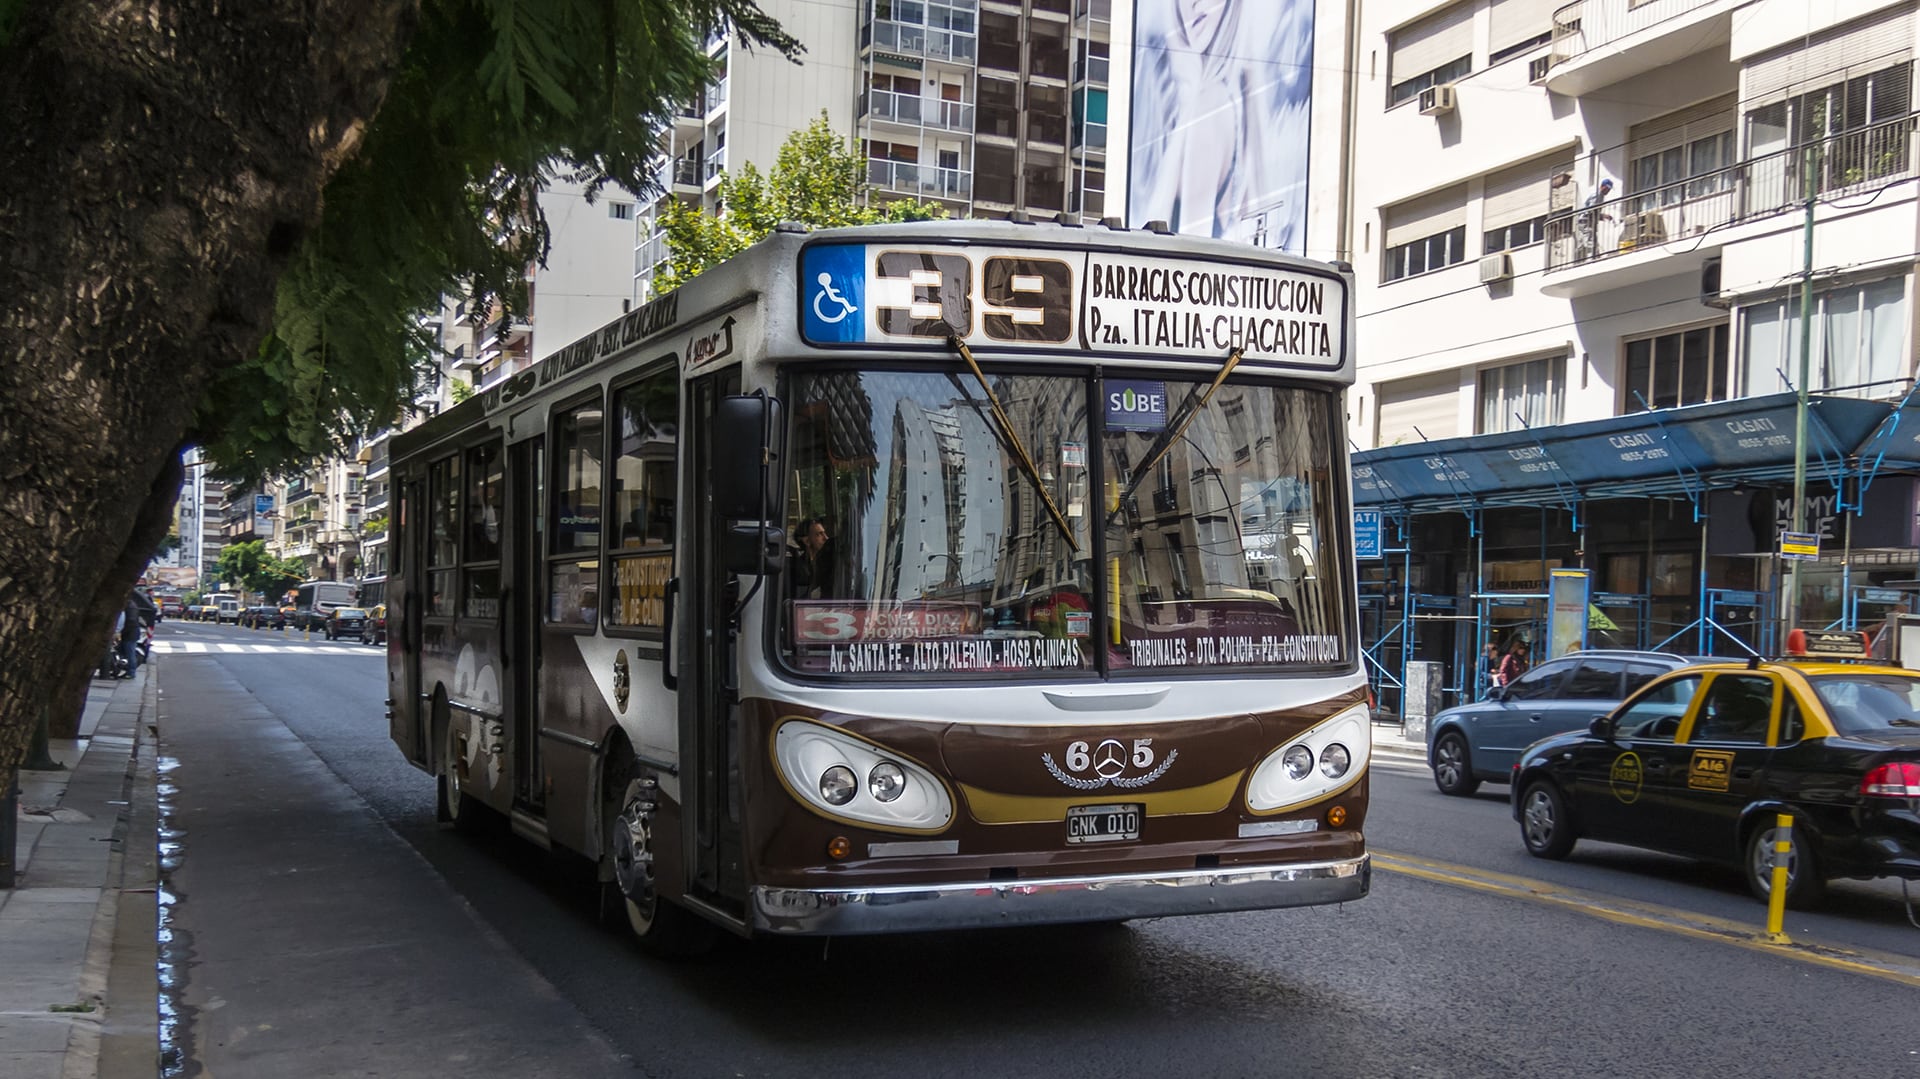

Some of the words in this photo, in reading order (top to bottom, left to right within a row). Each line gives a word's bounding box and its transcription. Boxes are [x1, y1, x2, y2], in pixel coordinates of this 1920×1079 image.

[875, 248, 1073, 344] 39
[1110, 388, 1161, 413] SUBE
[1726, 418, 1777, 434] CASATI
[1609, 433, 1655, 449] CASATI
[1354, 513, 1377, 523] ATI
[1776, 495, 1836, 519] MMY
[804, 612, 857, 640] 3
[830, 644, 846, 673] Av.
[850, 643, 885, 672] SANTA
[889, 642, 902, 671] FE
[913, 641, 939, 670] ALTO
[943, 640, 992, 670] PALERMO
[1003, 639, 1032, 668] HOSP.
[1034, 638, 1079, 667] CLINICAS
[1130, 639, 1187, 666] TRIBUNALES
[1219, 637, 1254, 663] POLICIA
[1283, 635, 1339, 662] CONSTITUCION
[1070, 815, 1098, 836] GNK
[1107, 813, 1136, 833] 010
